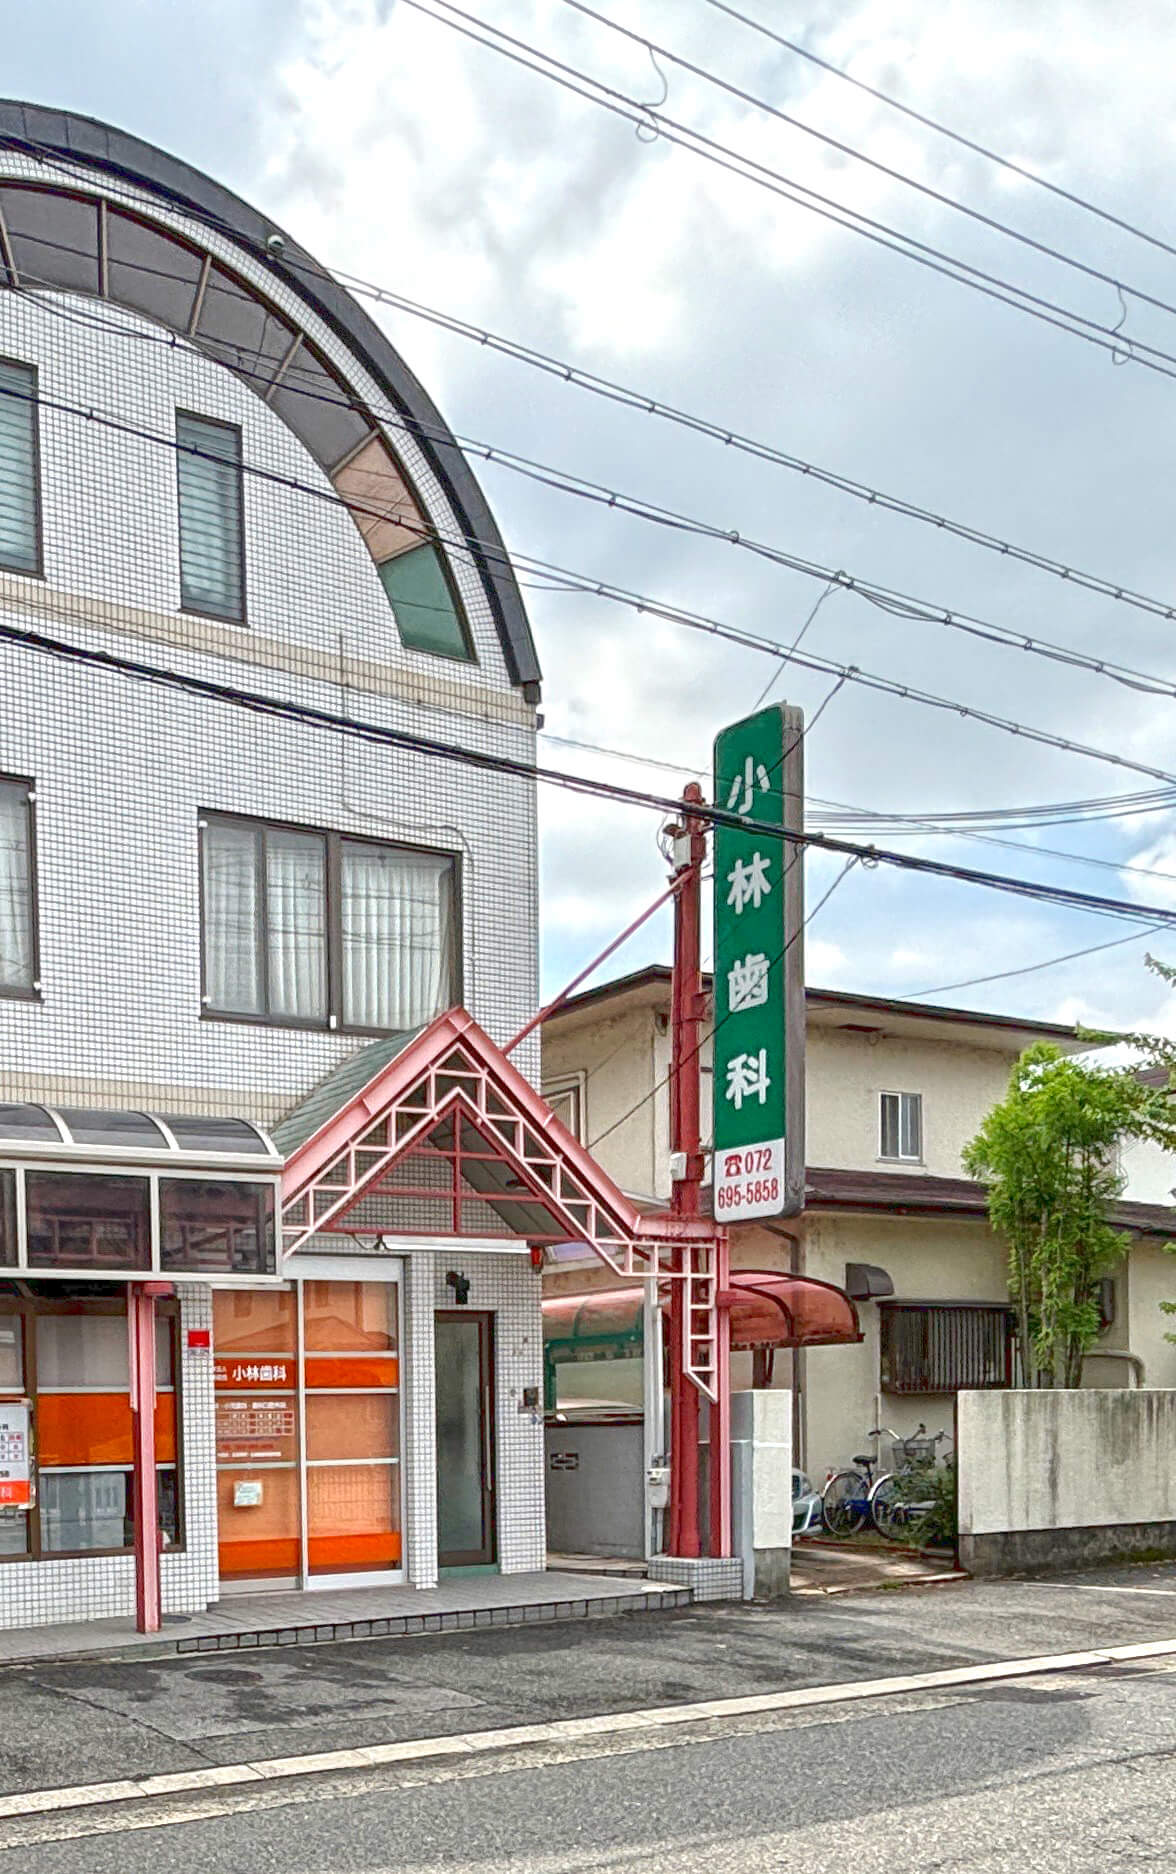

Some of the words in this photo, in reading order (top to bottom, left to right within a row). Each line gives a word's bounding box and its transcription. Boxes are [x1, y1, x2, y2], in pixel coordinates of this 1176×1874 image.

[726, 756, 772, 1110] 小林歯科
[745, 1148, 773, 1174] 072
[718, 1177, 779, 1209] 695-5858
[232, 1364, 287, 1382] 小林歯科
